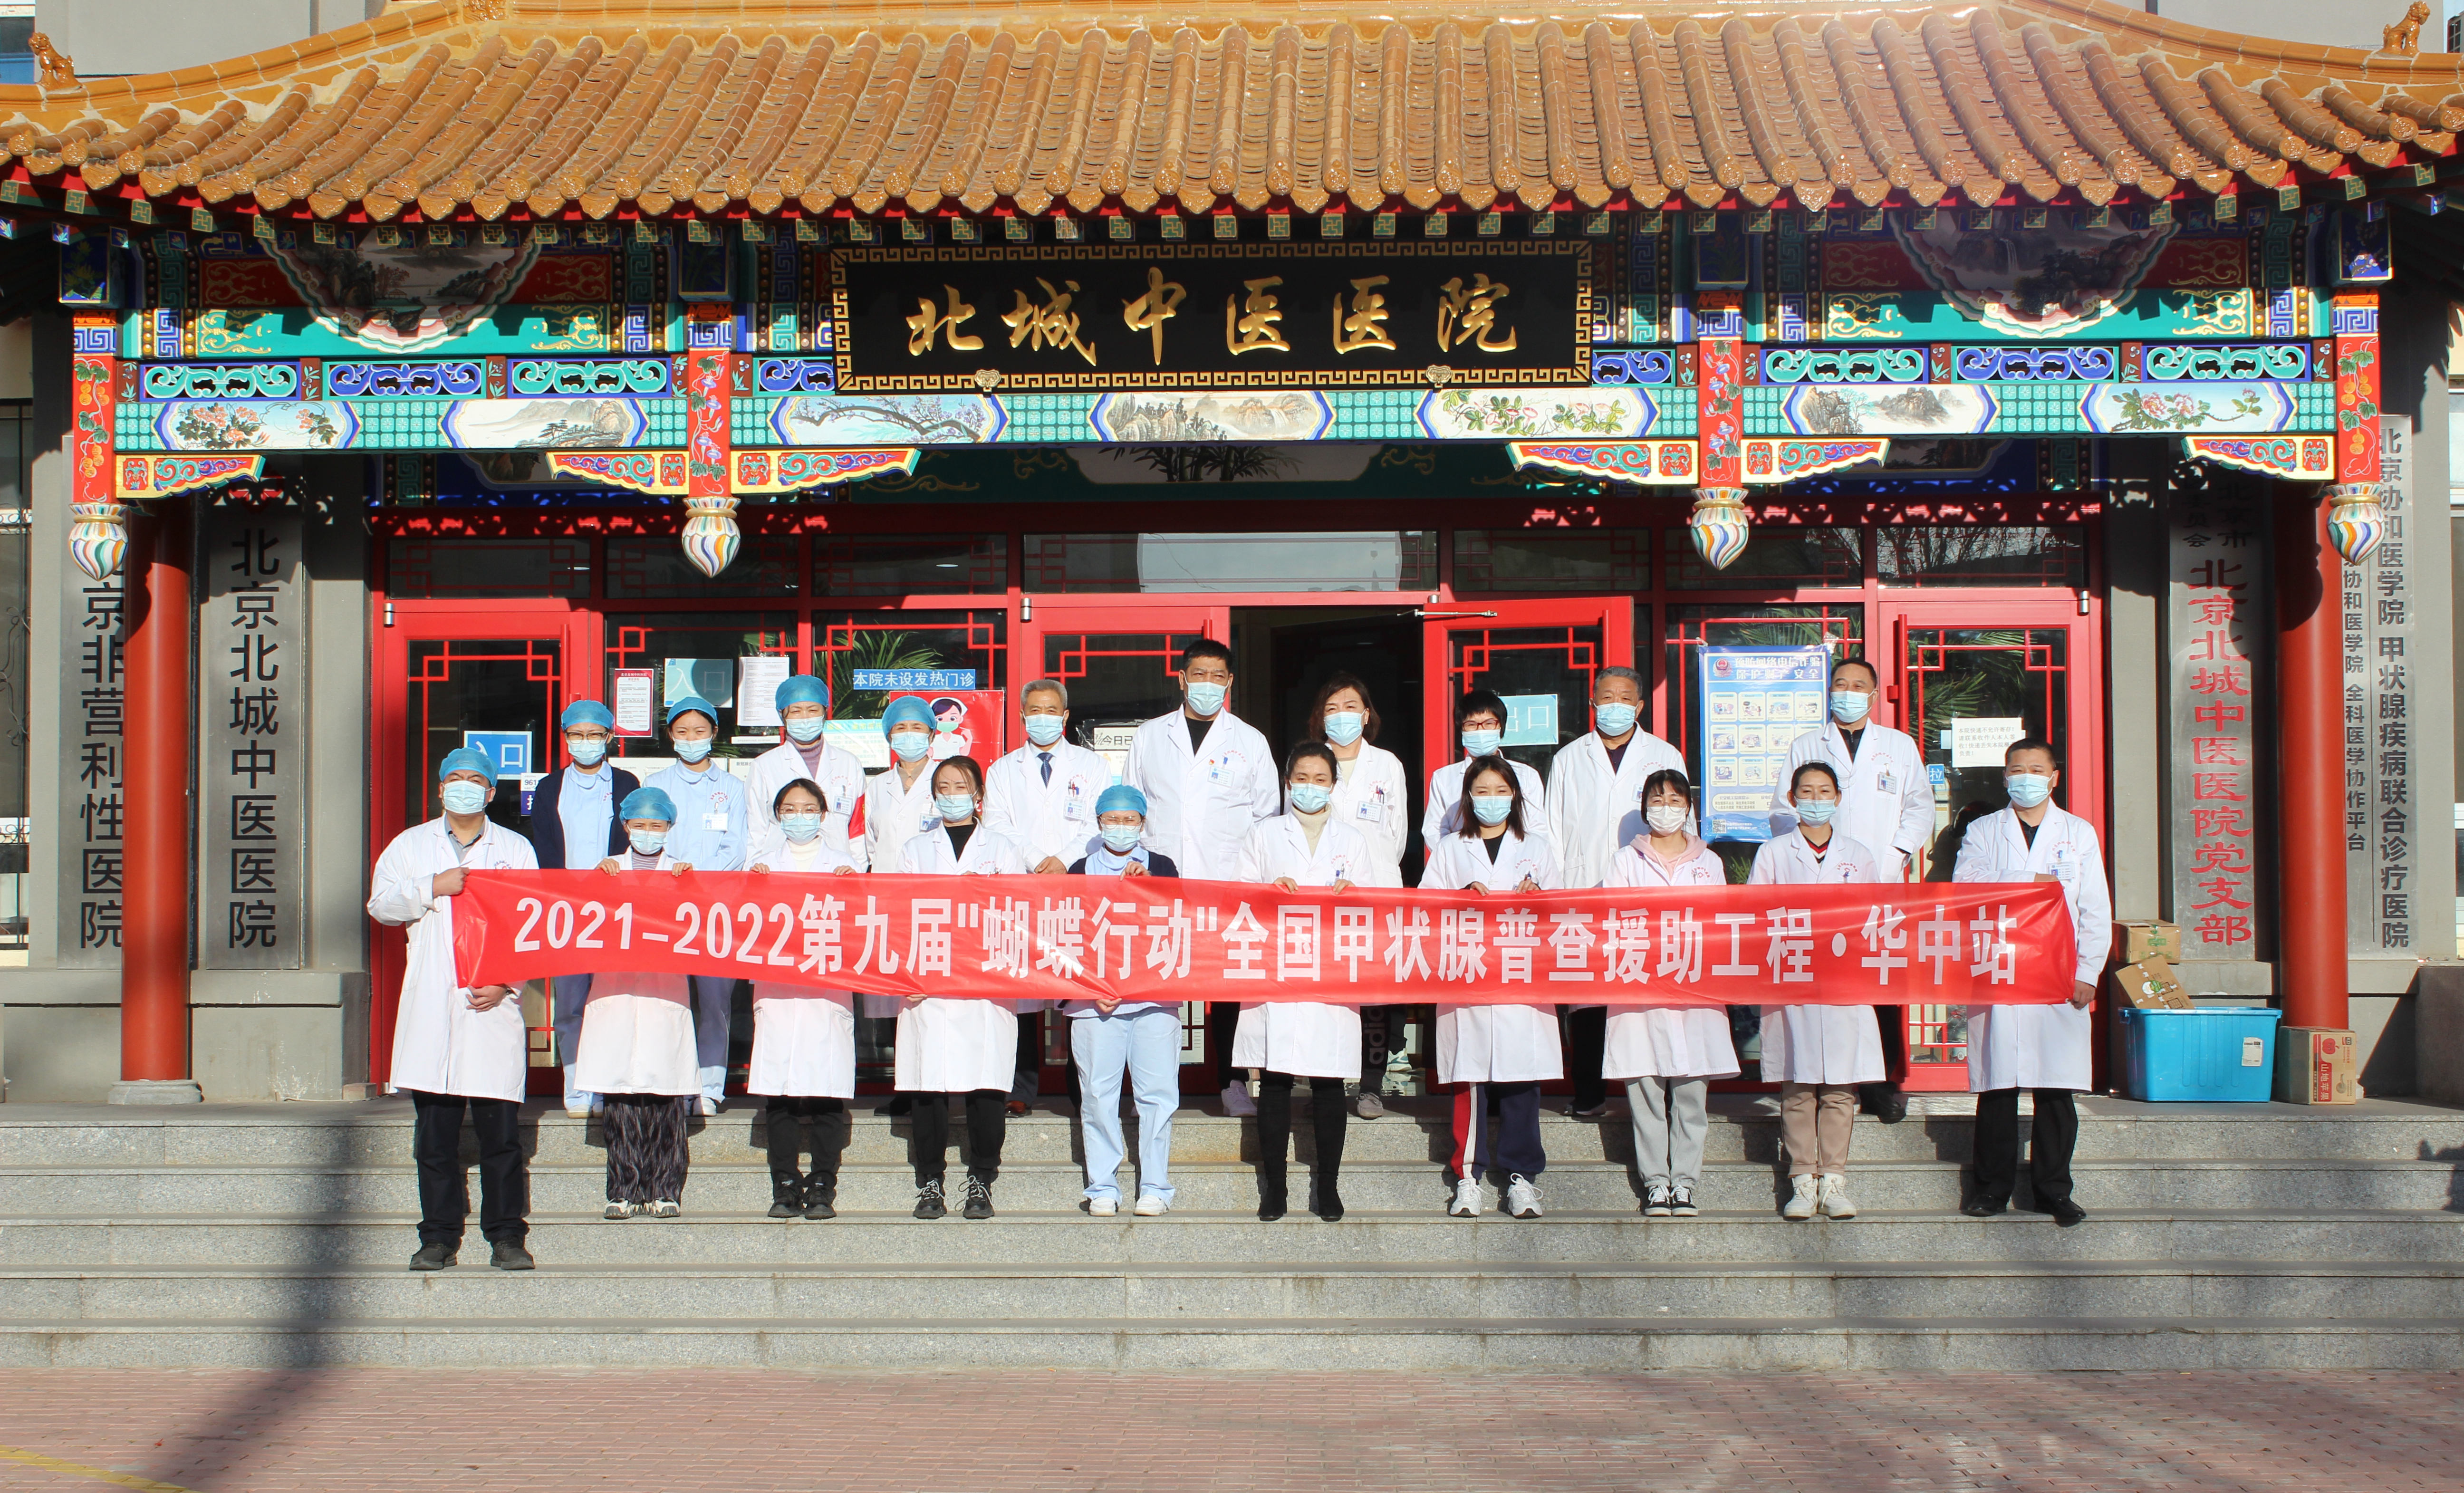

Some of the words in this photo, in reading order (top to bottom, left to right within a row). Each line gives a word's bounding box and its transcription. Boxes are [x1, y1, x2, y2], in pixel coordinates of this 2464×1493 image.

[908, 266, 1517, 366] 北城中医医院
[668, 667, 725, 693] 入口
[853, 671, 974, 687] 本院未设发热门诊
[1735, 657, 1821, 667] 预防网络电信诈骗
[1736, 668, 1819, 680] 保护财产安全
[79, 563, 124, 949] 京非营利性医院
[228, 528, 279, 949] 北京北城中医医院
[2188, 559, 2253, 946] 北京北城中医医院党支部
[2345, 684, 2365, 852] 全科医学协作平台
[1929, 768, 1943, 782] 拉
[2378, 636, 2409, 949] 甲状腺疾病联合诊疗医院
[2320, 1064, 2329, 1100] 山地苹果
